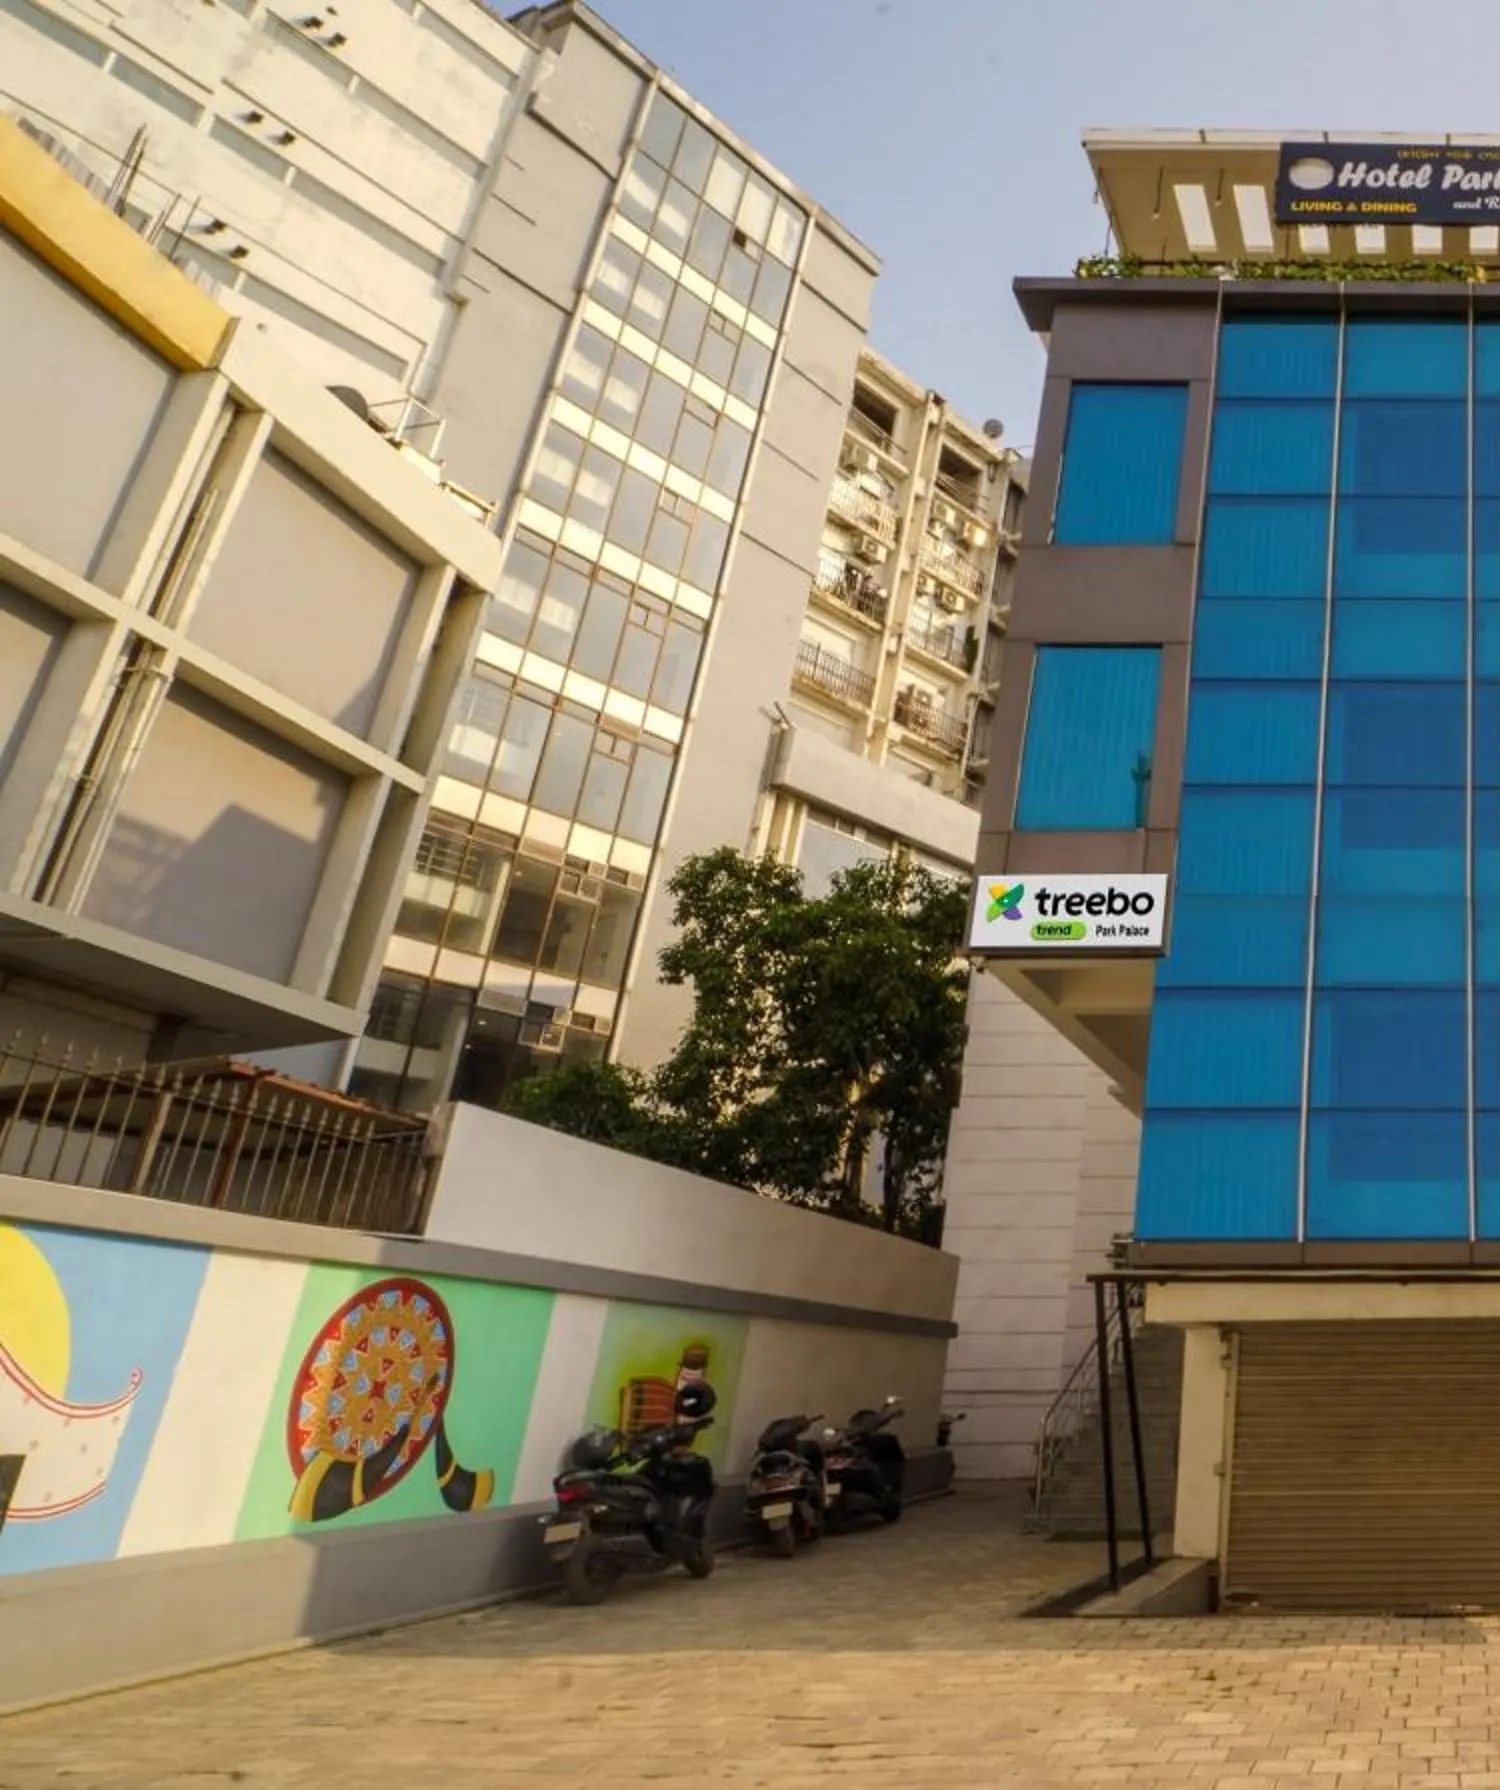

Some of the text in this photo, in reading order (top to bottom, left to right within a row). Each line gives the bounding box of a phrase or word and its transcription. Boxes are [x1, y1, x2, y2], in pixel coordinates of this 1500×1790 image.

[1337, 161, 1433, 190] Hotel
[1290, 201, 1341, 213] LIVING
[1361, 202, 1417, 214] DINING
[1453, 198, 1482, 211] and
[1034, 886, 1155, 917] treebo
[1036, 923, 1072, 936] trend
[1095, 924, 1150, 937] Park Palace
